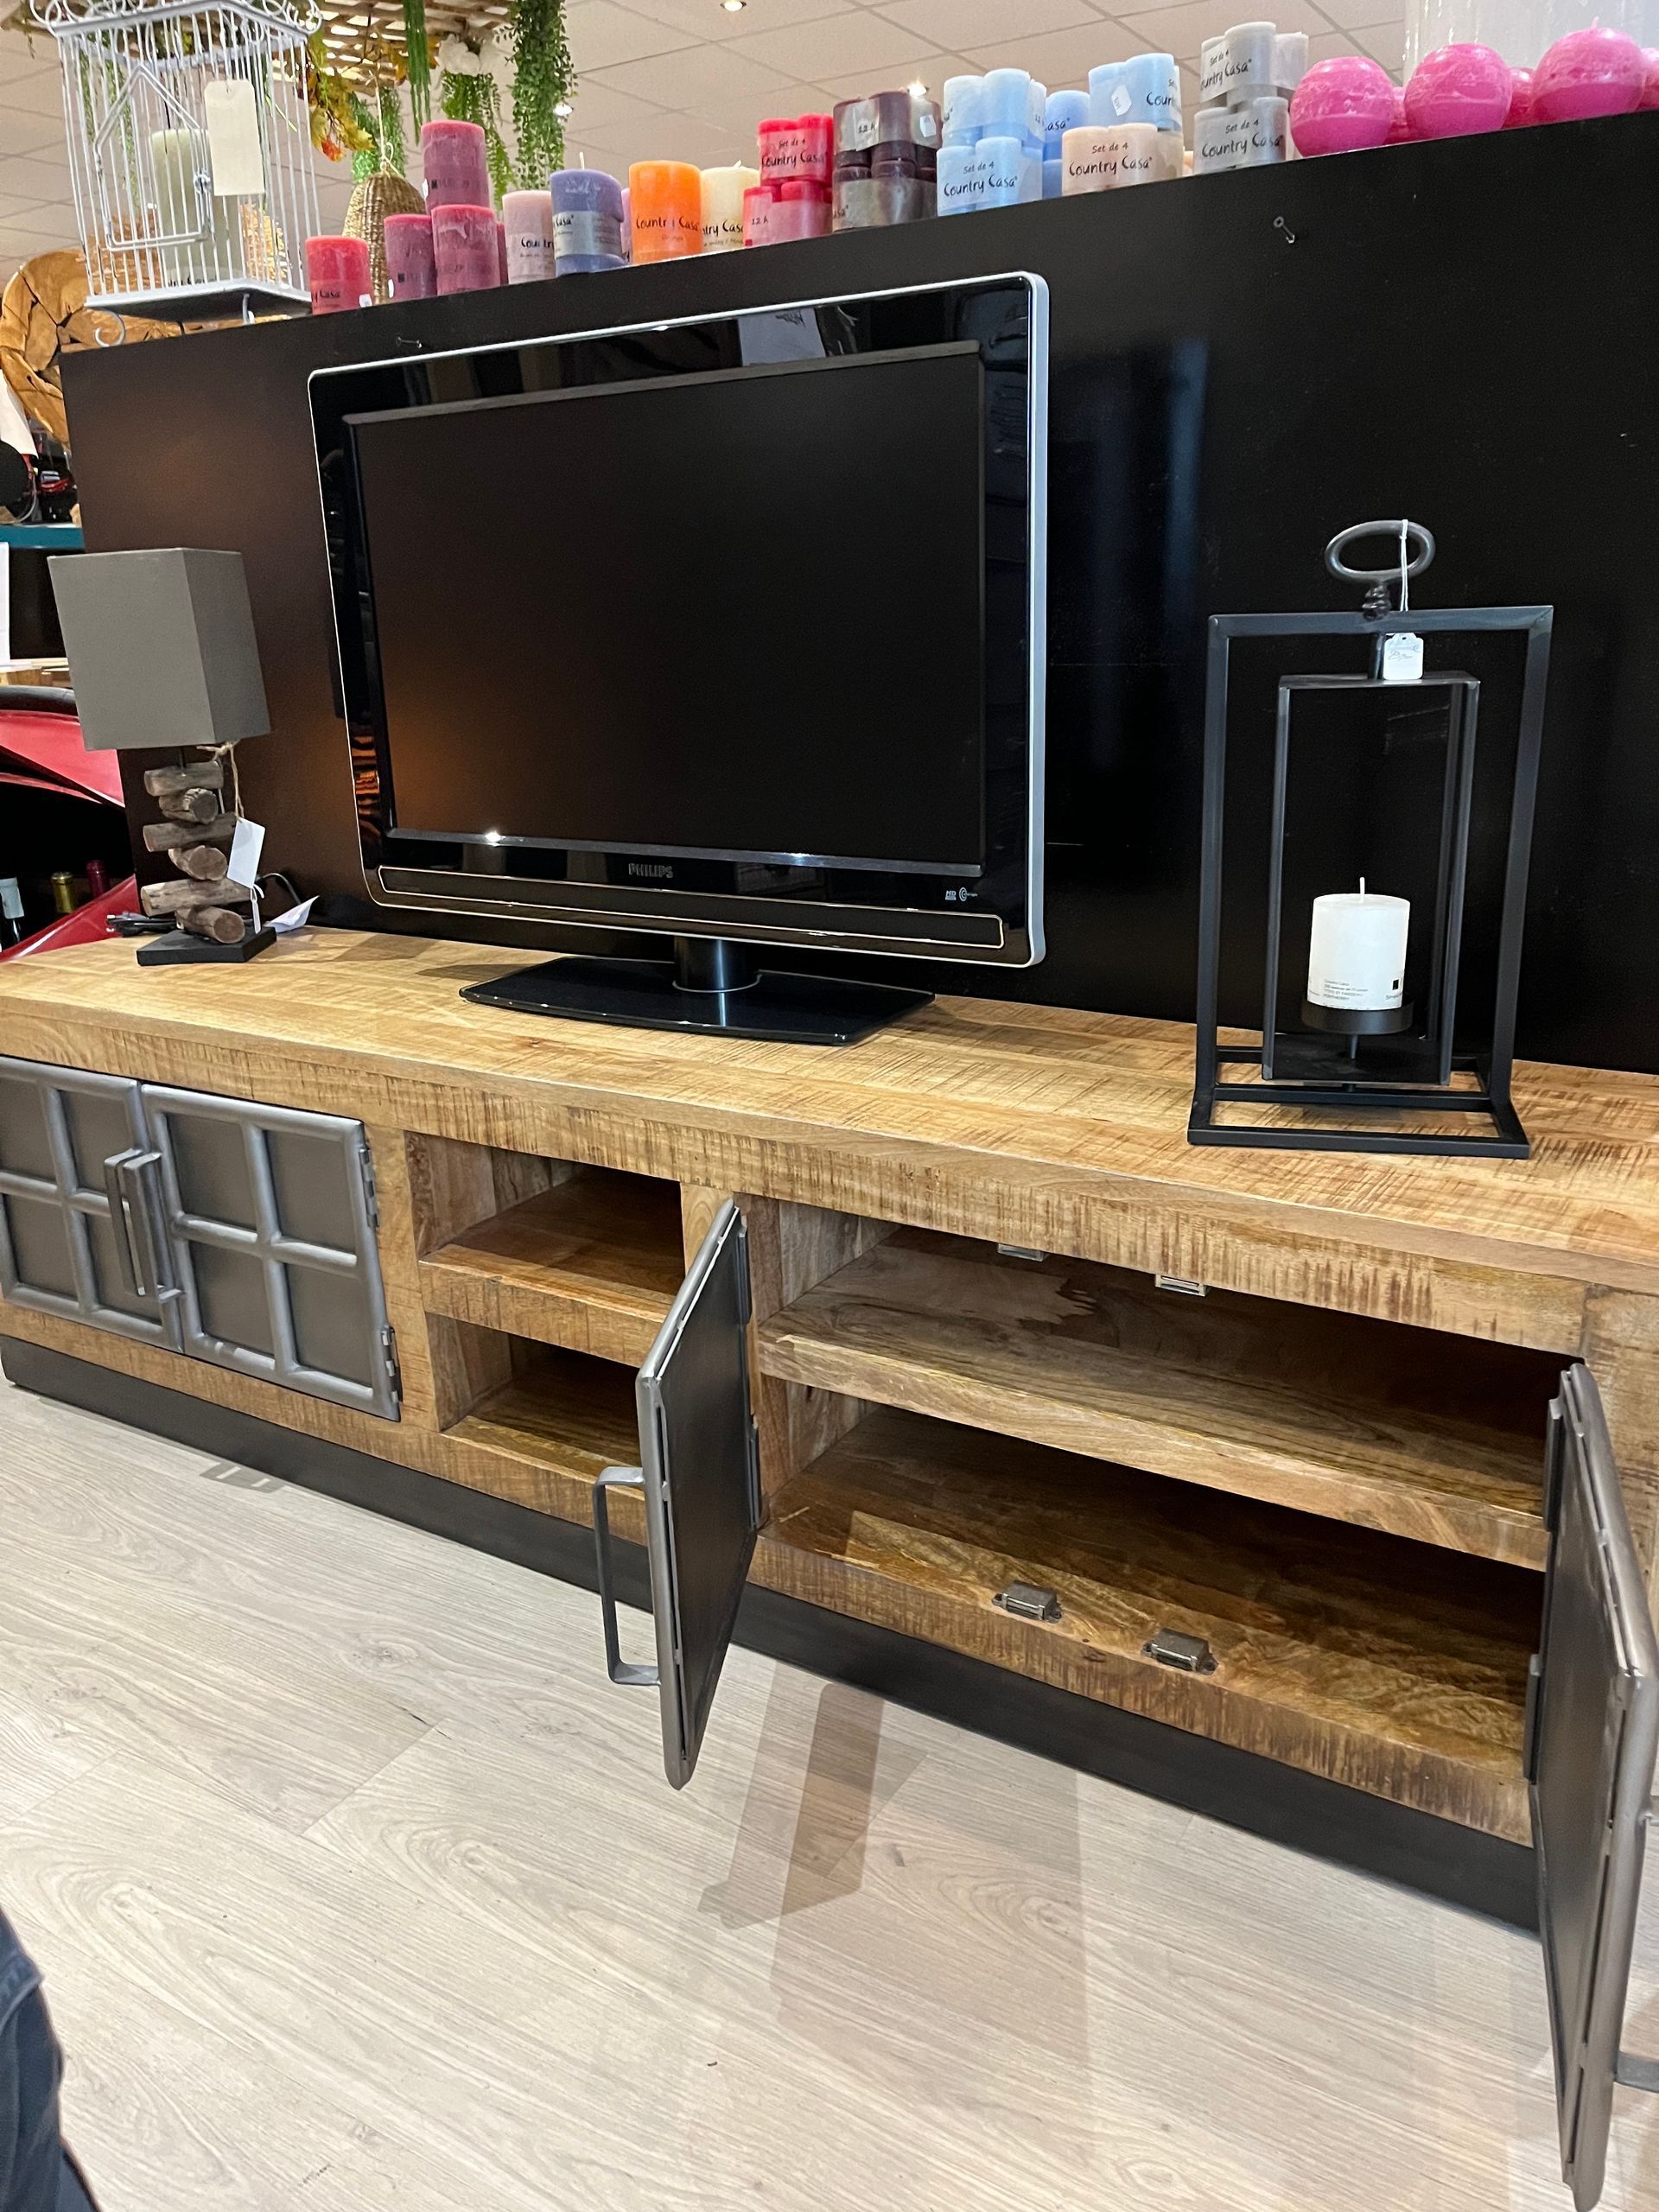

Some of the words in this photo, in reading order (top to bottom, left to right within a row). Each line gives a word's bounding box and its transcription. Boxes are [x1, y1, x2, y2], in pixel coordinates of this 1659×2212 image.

[1045, 120, 1066, 131] asa
[1225, 124, 1238, 134] Set
[1240, 120, 1250, 130] de
[1092, 144, 1106, 154] Set
[1109, 142, 1120, 152] de
[1202, 139, 1248, 157] Country
[761, 154, 797, 168] Country
[1069, 160, 1117, 177] Country
[1122, 156, 1151, 169] Casa
[963, 164, 975, 175] Set
[977, 162, 987, 171] de
[944, 179, 984, 197] Country
[988, 174, 1016, 188] Casa
[751, 216, 762, 225] 12
[763, 215, 769, 224] h
[628, 862, 674, 879] PHILIPS
